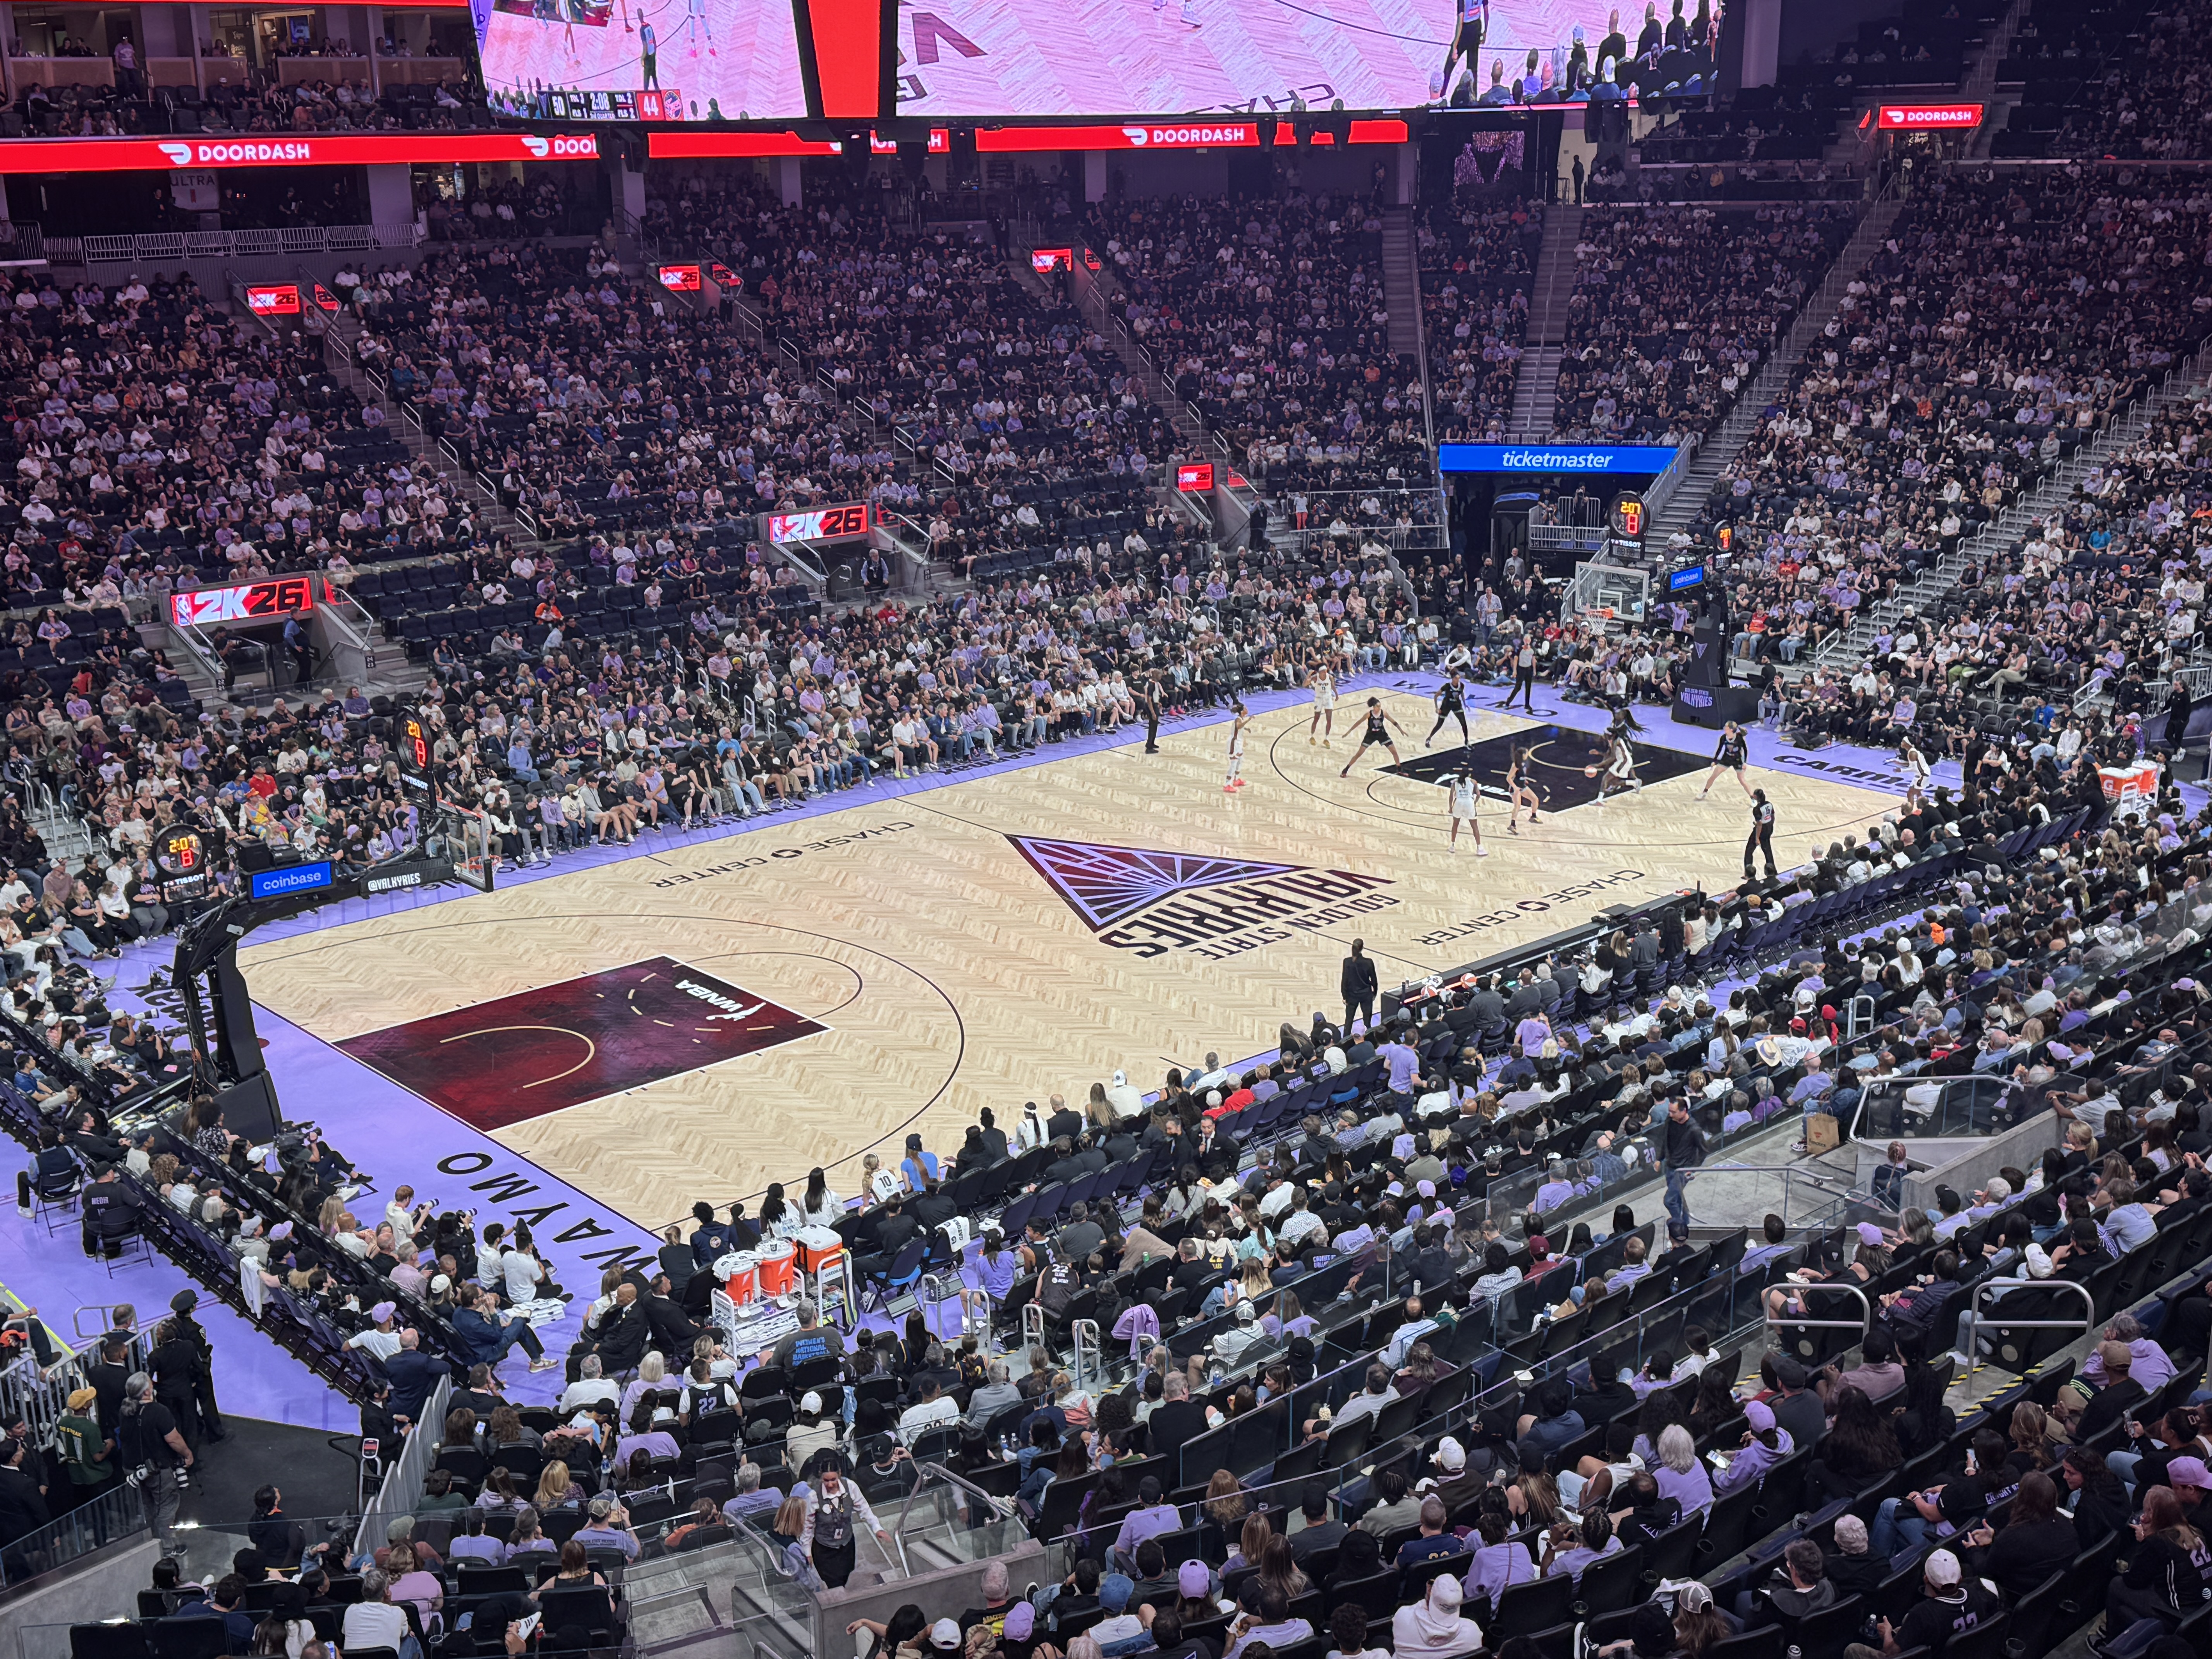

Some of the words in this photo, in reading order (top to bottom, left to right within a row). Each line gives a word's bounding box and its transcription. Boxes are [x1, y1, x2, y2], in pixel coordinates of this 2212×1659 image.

[552, 96, 565, 116] 50
[590, 93, 611, 110] 2:08
[643, 95, 658, 116] 44
[1908, 111, 1972, 121] DOORDASH
[1153, 128, 1244, 142] DOORDASH
[199, 143, 310, 161] DOORDASH
[1503, 450, 1613, 469] ticketmaster
[1620, 501, 1641, 514] 2:07
[1626, 514, 1639, 535] 8
[1680, 692, 1712, 708] VALKYRIES
[169, 834, 198, 853] 2:07
[802, 821, 915, 851] CHASE
[180, 849, 193, 867] 8
[174, 873, 204, 885] TISSOT
[263, 872, 321, 890] coinbase
[368, 872, 421, 891] @VALKYRIES
[648, 857, 769, 888] CENTER
[1543, 869, 1645, 904] CHASE
[1099, 869, 1397, 958] VALKYRIES
[1283, 893, 1400, 931] GOLDEN
[1410, 910, 1521, 946] CENTER
[1188, 926, 1292, 960] STATE
[675, 979, 743, 1012] WNBA
[879, 1175, 892, 1188] 10
[437, 1152, 658, 1279] WAYMO
[1051, 1264, 1069, 1273] 22
[795, 1336, 825, 1347] WOMEN'S
[699, 1396, 717, 1415] 22
